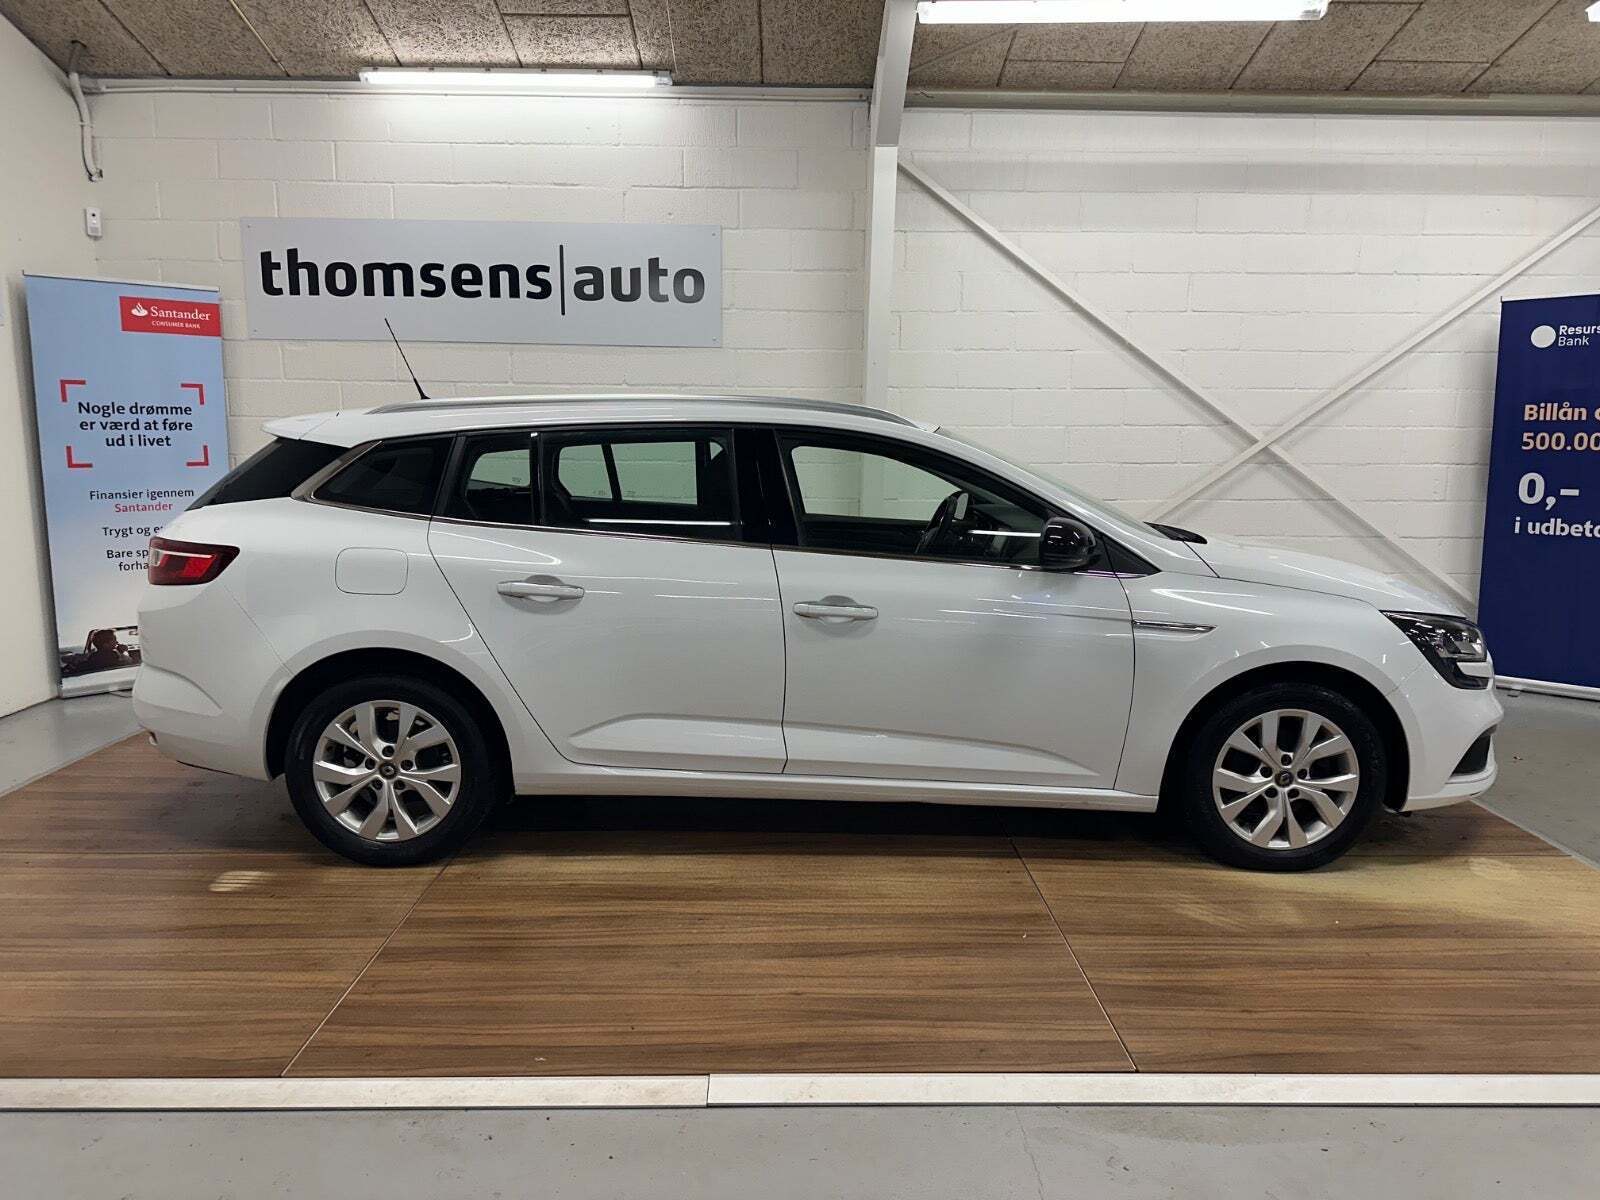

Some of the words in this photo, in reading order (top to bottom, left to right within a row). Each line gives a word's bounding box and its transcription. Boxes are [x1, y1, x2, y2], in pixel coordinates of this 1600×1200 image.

[260, 247, 551, 300] thomsens
[573, 257, 706, 304] auto
[150, 305, 211, 321] Santander
[1558, 335, 1590, 347] Bank
[78, 402, 125, 418] Nogle
[129, 402, 192, 416] drømme
[1524, 401, 1587, 421] Billån
[79, 420, 96, 430] er
[100, 418, 140, 431] værd
[144, 420, 159, 431] at
[162, 418, 193, 432] føre
[105, 434, 125, 447] ud
[129, 434, 134, 447] i
[138, 434, 171, 447] livet
[89, 490, 144, 501] Finansier
[146, 489, 194, 501] igennem
[114, 502, 173, 513] Santander
[1514, 516, 1521, 534] i
[102, 526, 134, 538] Trygt
[136, 527, 151, 537] og
[106, 549, 133, 559] Bare
